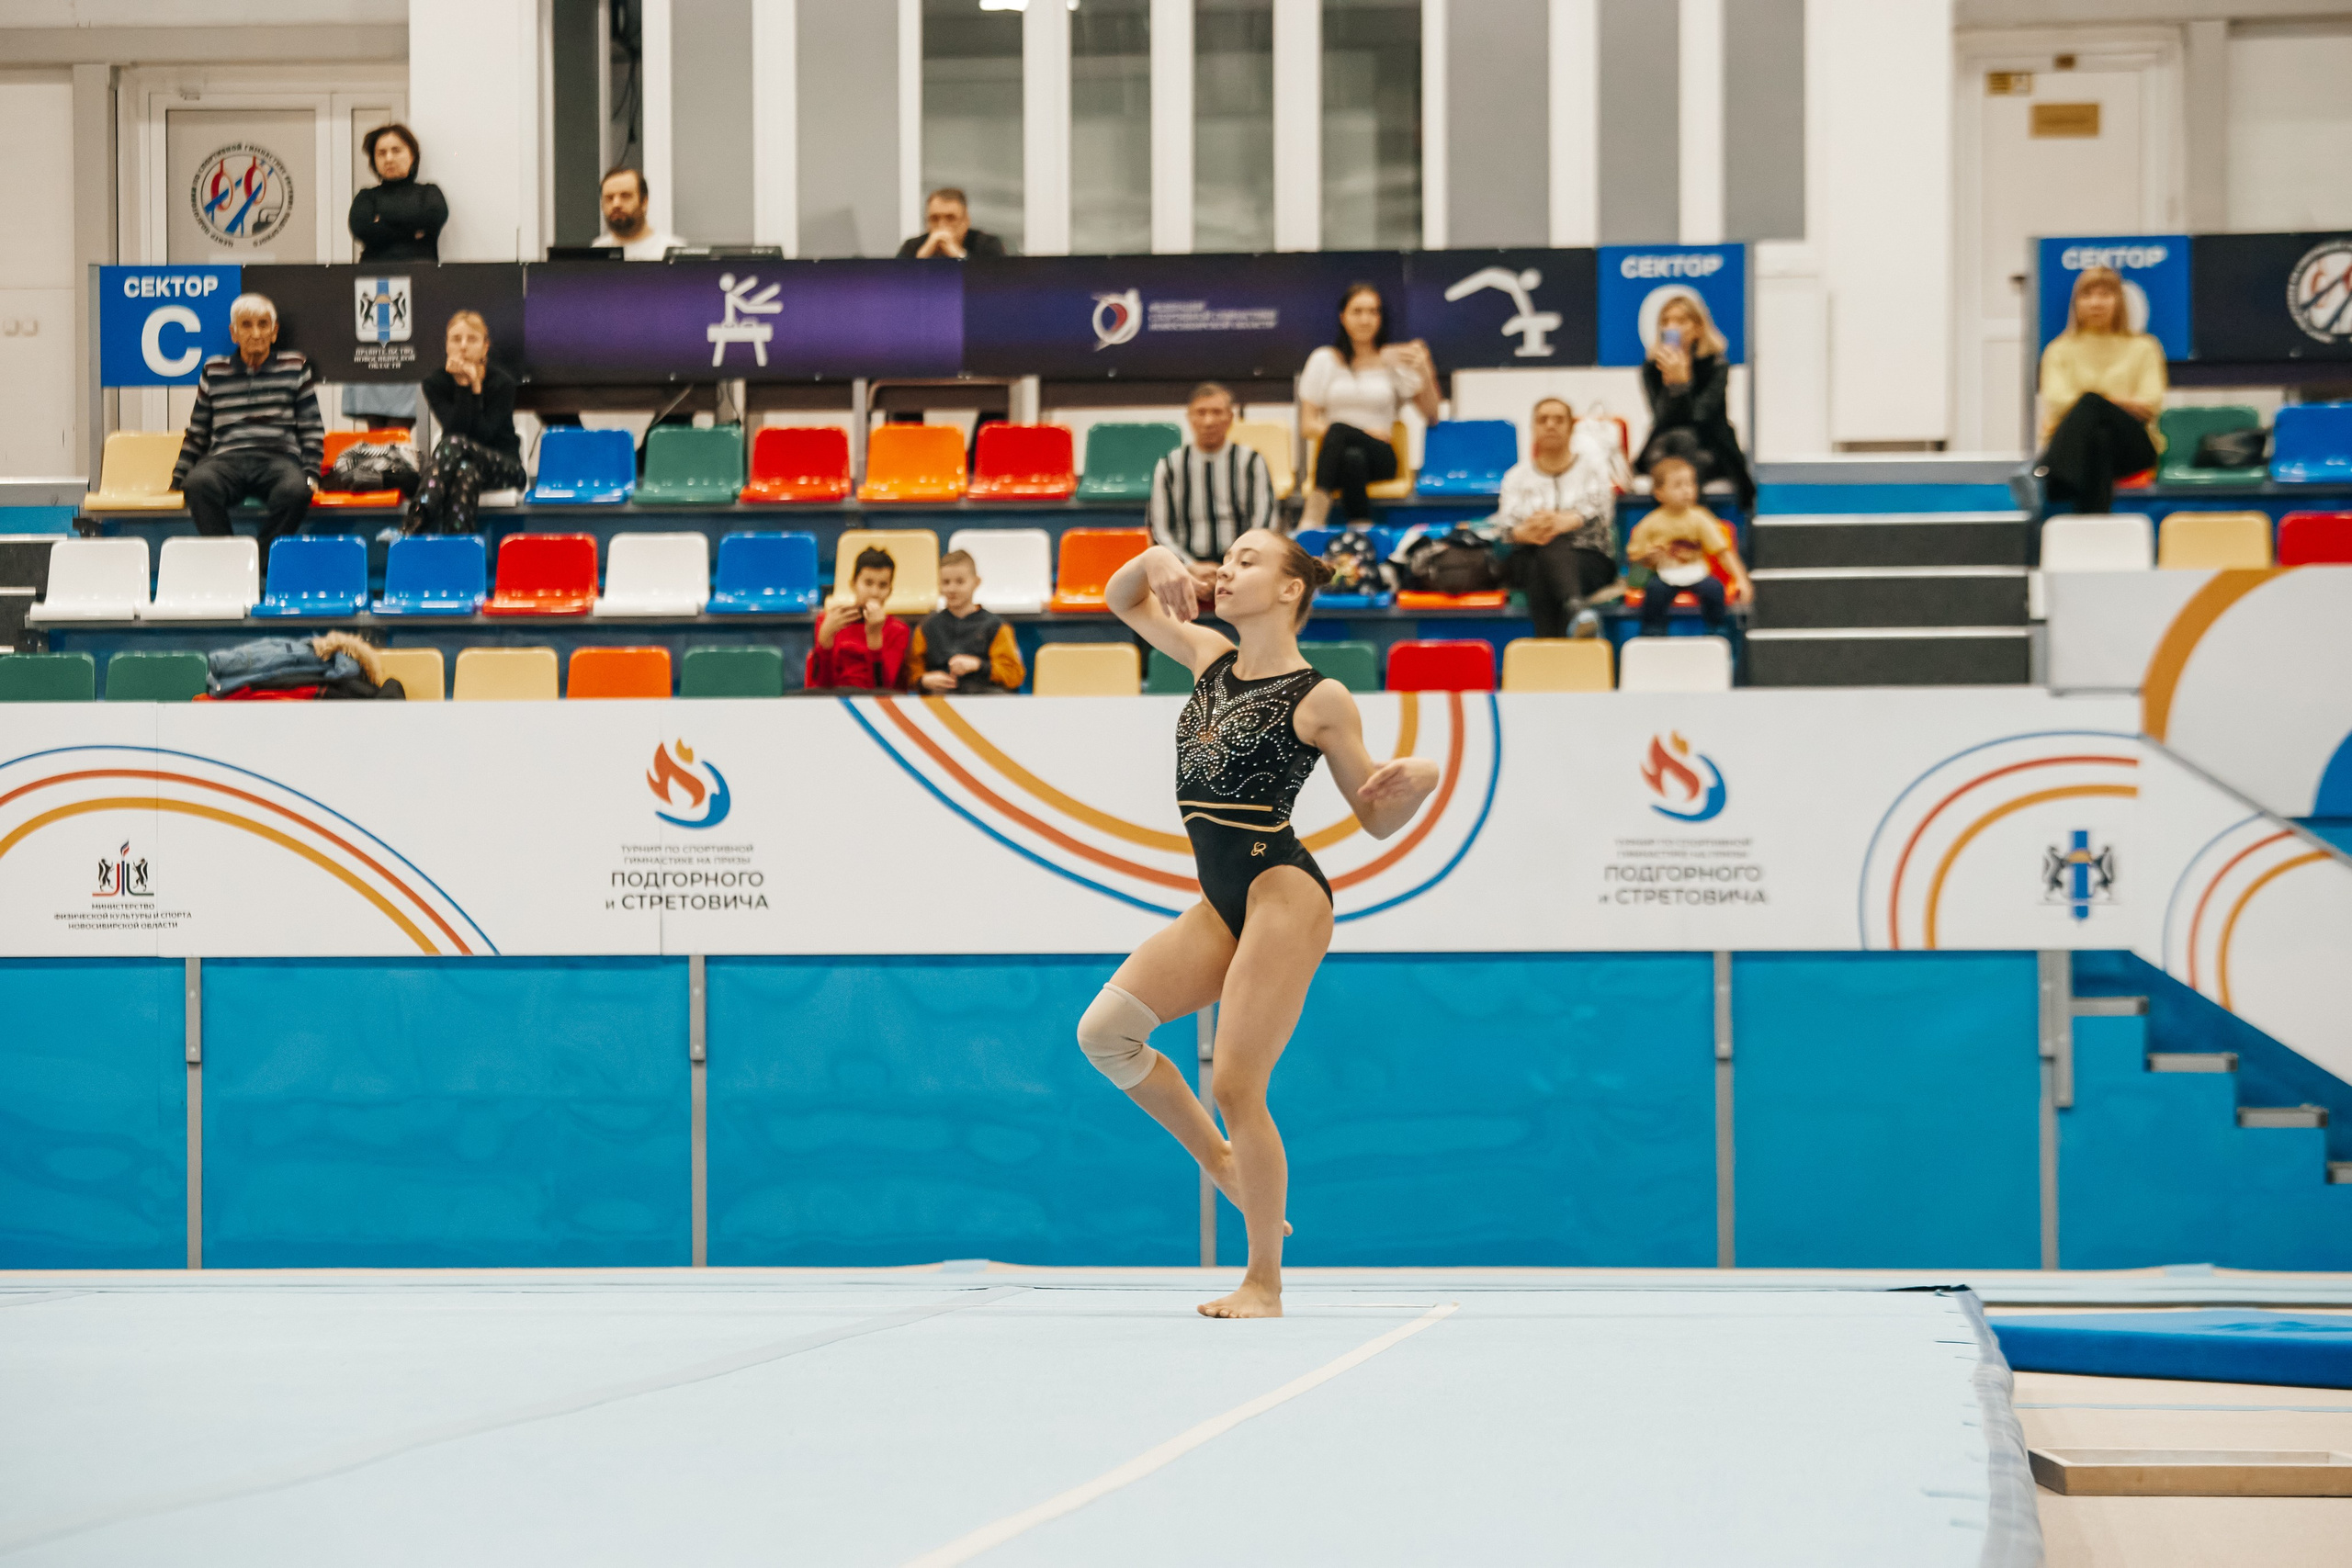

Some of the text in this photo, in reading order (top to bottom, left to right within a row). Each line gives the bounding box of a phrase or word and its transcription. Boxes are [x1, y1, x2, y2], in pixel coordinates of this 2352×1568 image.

[210, 233, 233, 247] ЦЕНТР
[1621, 254, 1724, 278] СЕКТОР
[2062, 246, 2168, 270] СЕКТОР
[124, 276, 219, 298] СЕКТОР
[141, 305, 202, 377] С
[621, 844, 754, 854] ТУРНИР ПО СПОРТИВНОЙ
[624, 857, 694, 865] ГИМНАСТИКЕ
[696, 857, 711, 865] НА
[611, 872, 764, 889] ПОДГОРНОГО
[1604, 866, 1761, 882] ПОДГОРНОГО
[605, 895, 769, 910] и СТРЕТОВИЧА
[1615, 888, 1766, 905] СТРЕТОВИЧА
[53, 912, 107, 920] ФИЗИЧЕСКОЙ
[160, 911, 192, 919] СПОРТА
[67, 921, 178, 930] НОВОСИБИРСКОЙ ОБЛАСТИ
